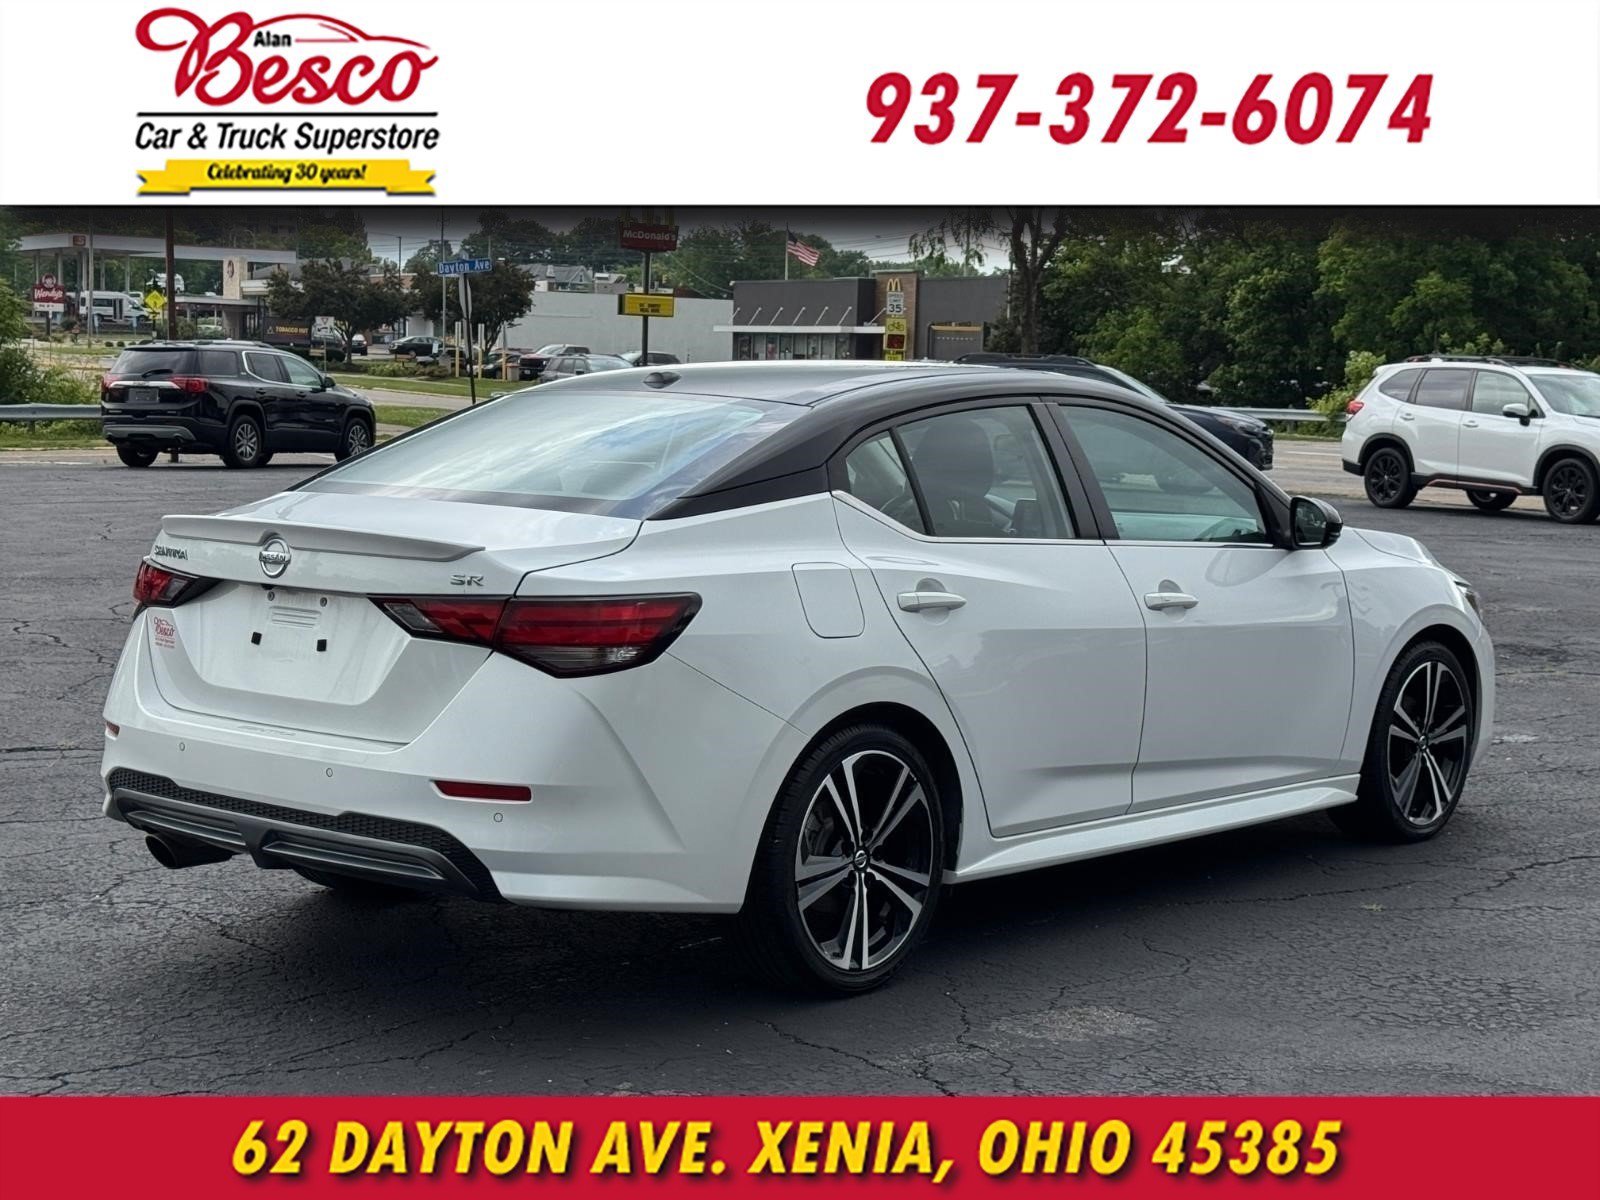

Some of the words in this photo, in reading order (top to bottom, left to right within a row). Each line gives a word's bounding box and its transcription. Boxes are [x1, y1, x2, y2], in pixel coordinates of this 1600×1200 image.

[622, 230, 677, 241] McDonald's
[439, 262, 470, 274] Dayton
[474, 260, 490, 270] Ave
[888, 303, 902, 313] 35
[275, 325, 299, 334] TOBACCO
[450, 574, 484, 587] SR
